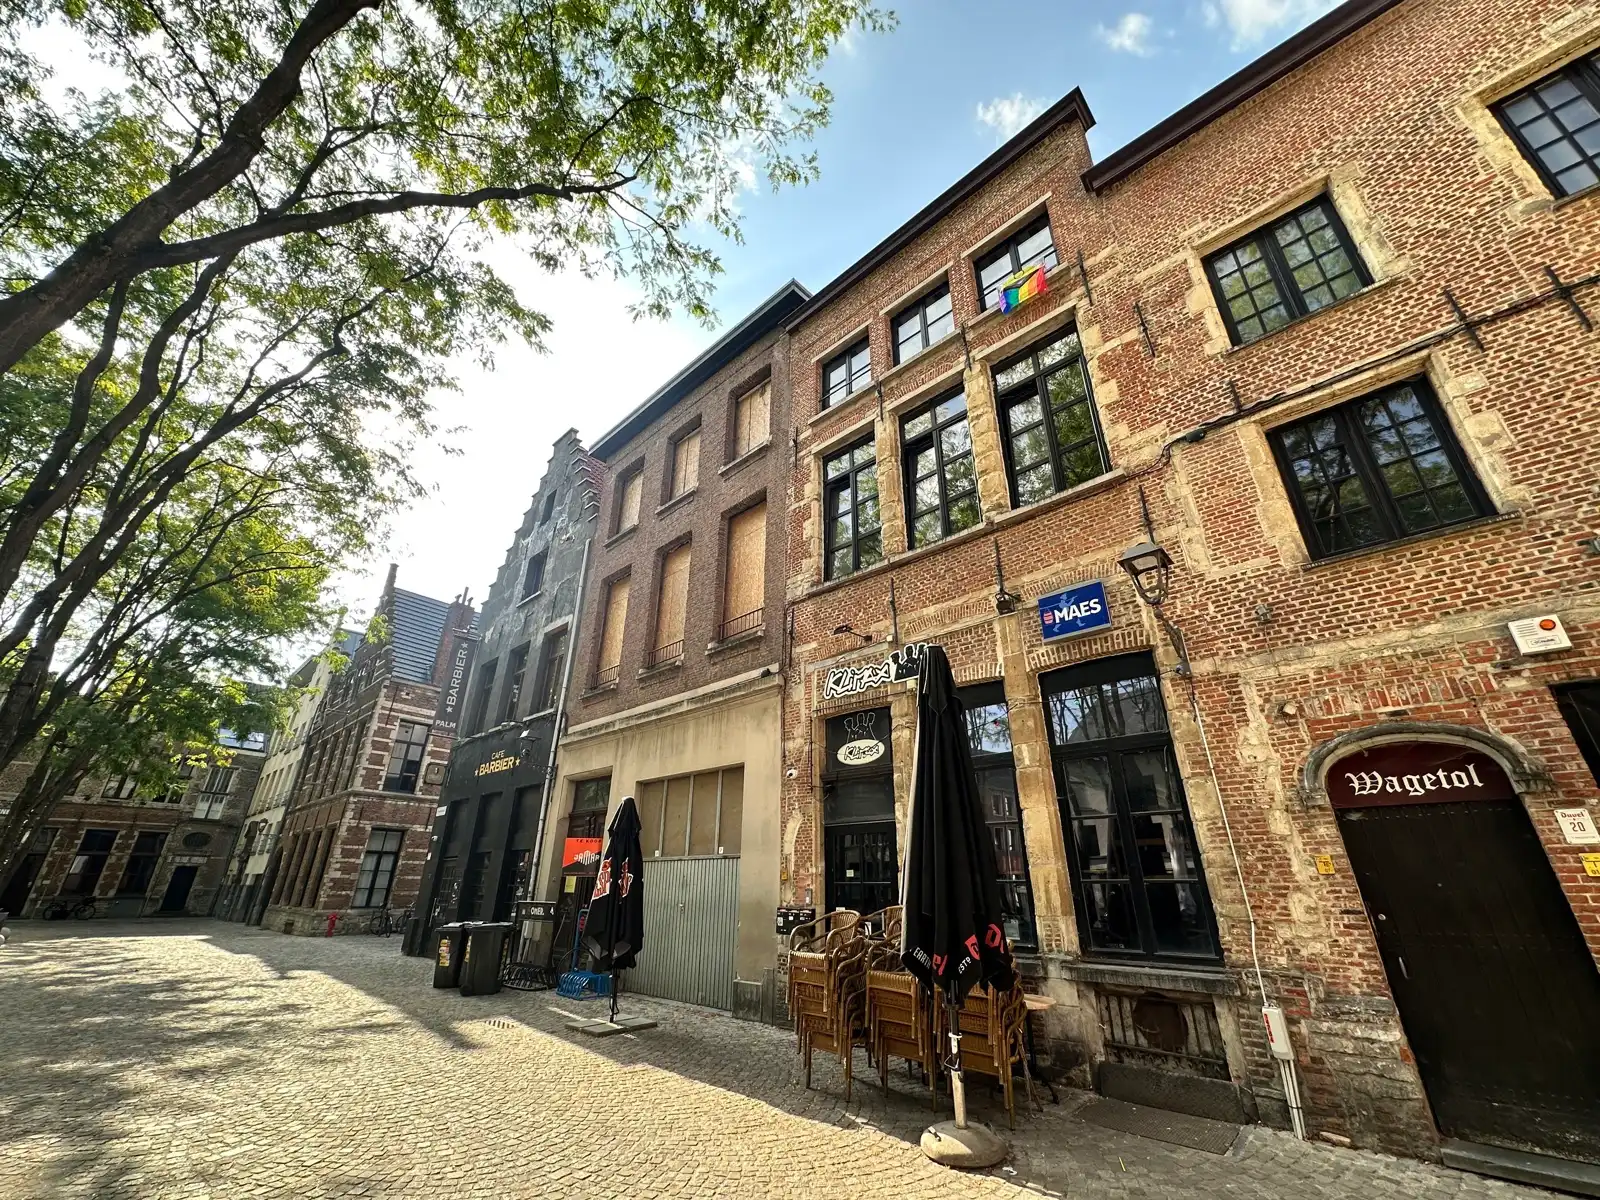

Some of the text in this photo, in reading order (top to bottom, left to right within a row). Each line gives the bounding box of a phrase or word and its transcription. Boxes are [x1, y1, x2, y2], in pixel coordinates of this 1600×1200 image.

[1054, 598, 1102, 624] MAES
[446, 650, 468, 706] BARBIER
[435, 719, 457, 729] PALM
[478, 757, 515, 776] BARBIER
[1344, 762, 1484, 797] Wagetol
[1560, 811, 1585, 819] Duvel
[1569, 821, 1586, 832] 20
